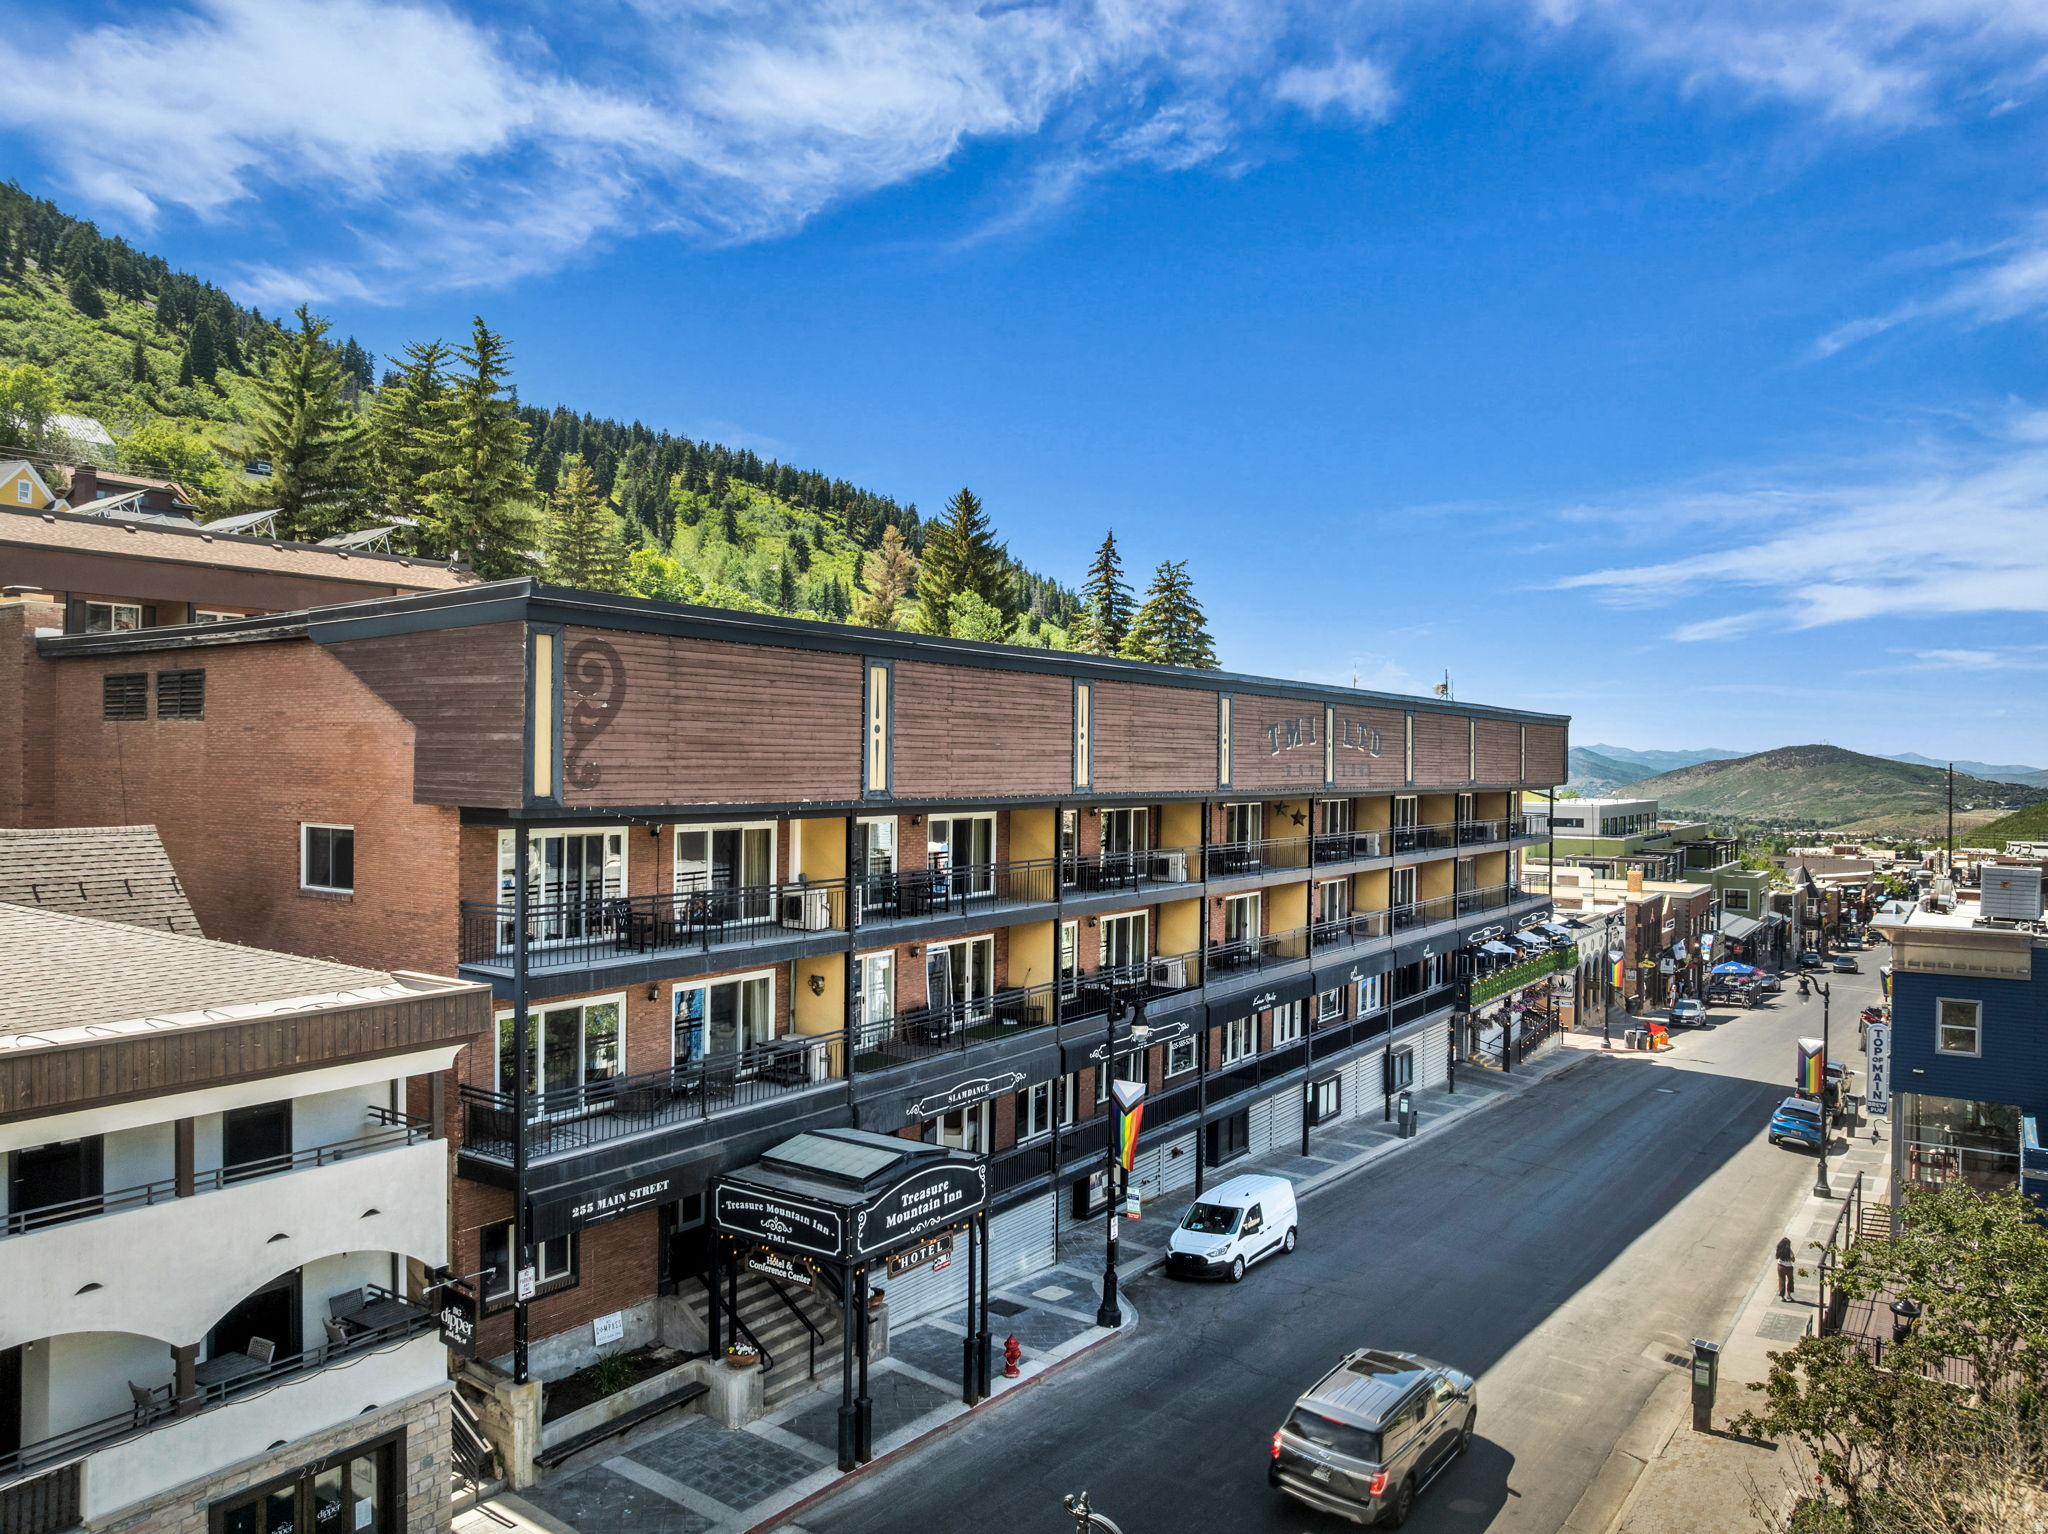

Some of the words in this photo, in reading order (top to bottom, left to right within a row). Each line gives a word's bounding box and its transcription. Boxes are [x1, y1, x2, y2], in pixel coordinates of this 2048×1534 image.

[1343, 719, 1380, 757] LTD
[1873, 1029, 1883, 1055] TOP
[948, 1084, 990, 1103] SLAMDANCE
[1872, 1064, 1883, 1100] MAIN
[1867, 1101, 1886, 1109] BREW
[572, 1203, 594, 1218] 255
[597, 1193, 626, 1210] MAIN
[629, 1180, 670, 1201] STREET
[902, 1181, 949, 1207] Treasure
[725, 1201, 764, 1211] Treasure
[766, 1203, 810, 1226] Mountain
[812, 1219, 829, 1235] Inn
[886, 1198, 941, 1228] Mountain
[943, 1189, 963, 1205] Inn
[766, 1232, 786, 1244] TMI
[766, 1256, 785, 1269] Hotel
[786, 1261, 793, 1271] &
[900, 1241, 943, 1268] HOTEL
[748, 1260, 787, 1278] Conference
[788, 1270, 811, 1285] Center
[441, 1307, 473, 1335] dipper
[300, 1459, 327, 1479] 227
